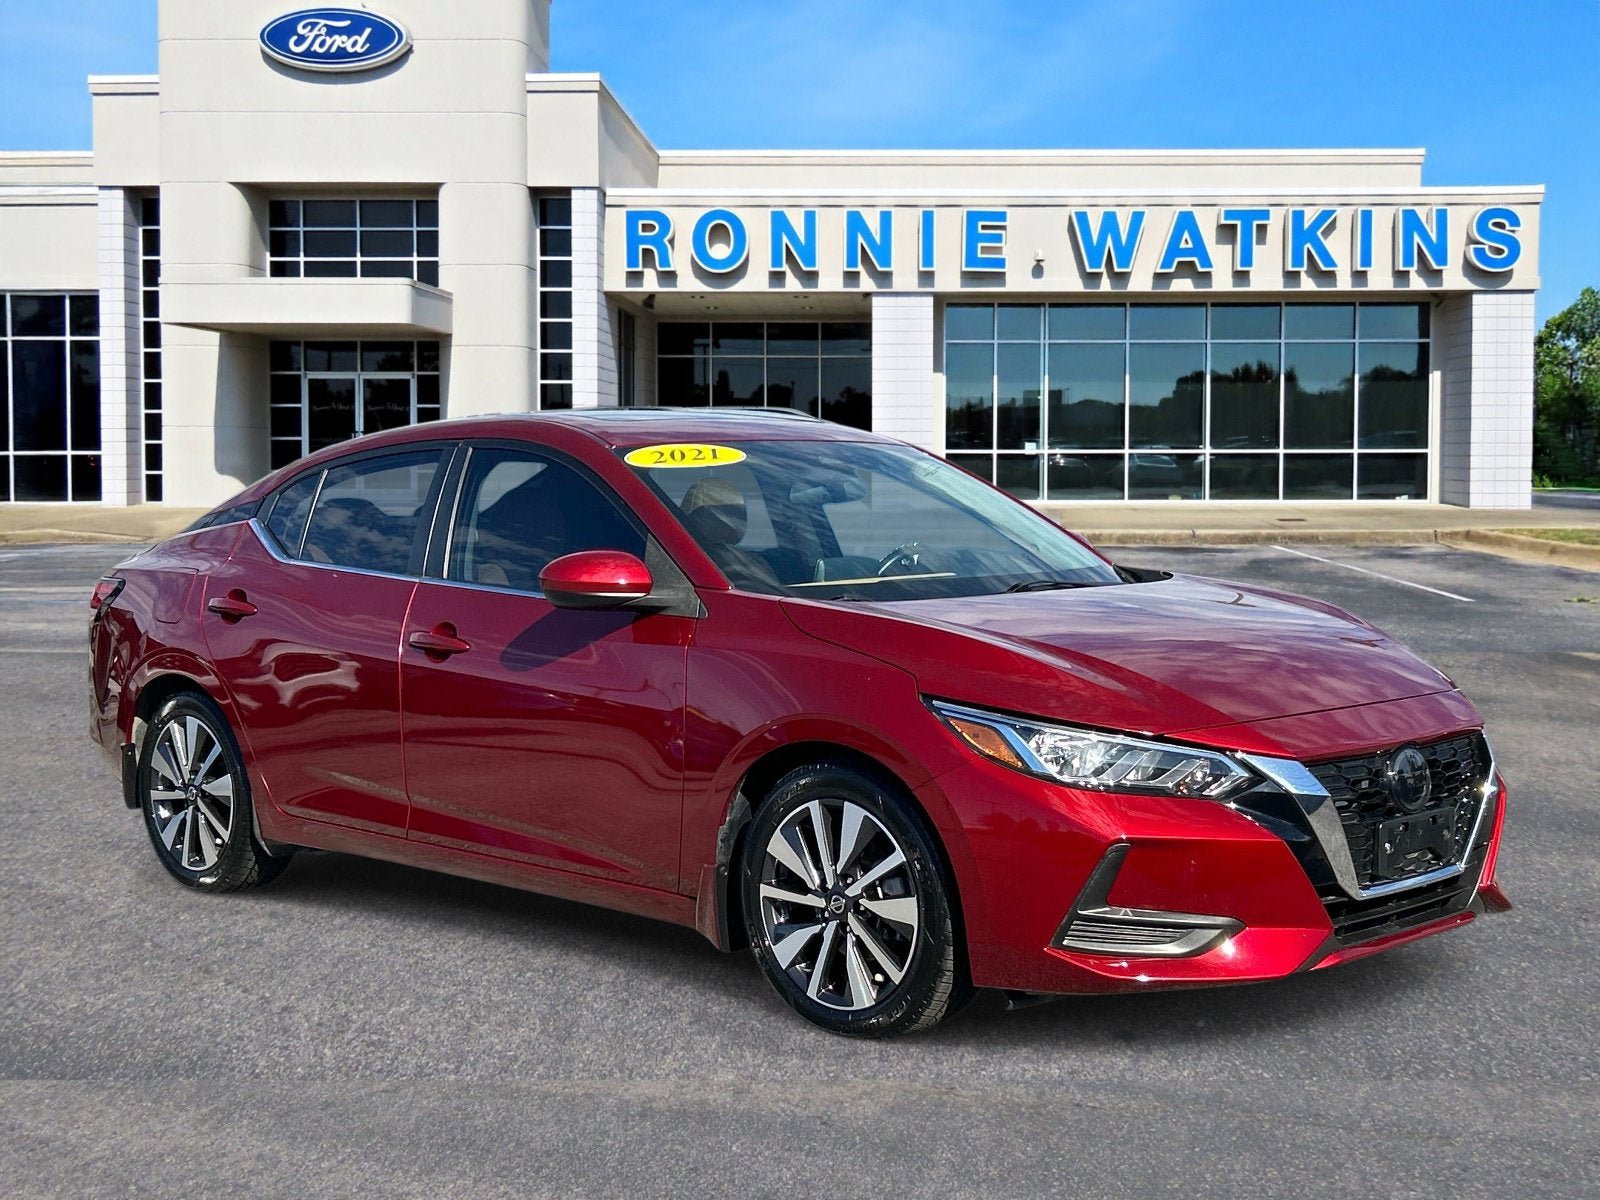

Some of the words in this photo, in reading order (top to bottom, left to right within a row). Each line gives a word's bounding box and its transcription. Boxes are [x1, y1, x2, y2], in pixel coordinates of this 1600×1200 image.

[289, 18, 373, 54] Ford
[624, 208, 1009, 274] RONNIE
[1069, 206, 1523, 273] WATKINS
[650, 448, 720, 465] 2021
